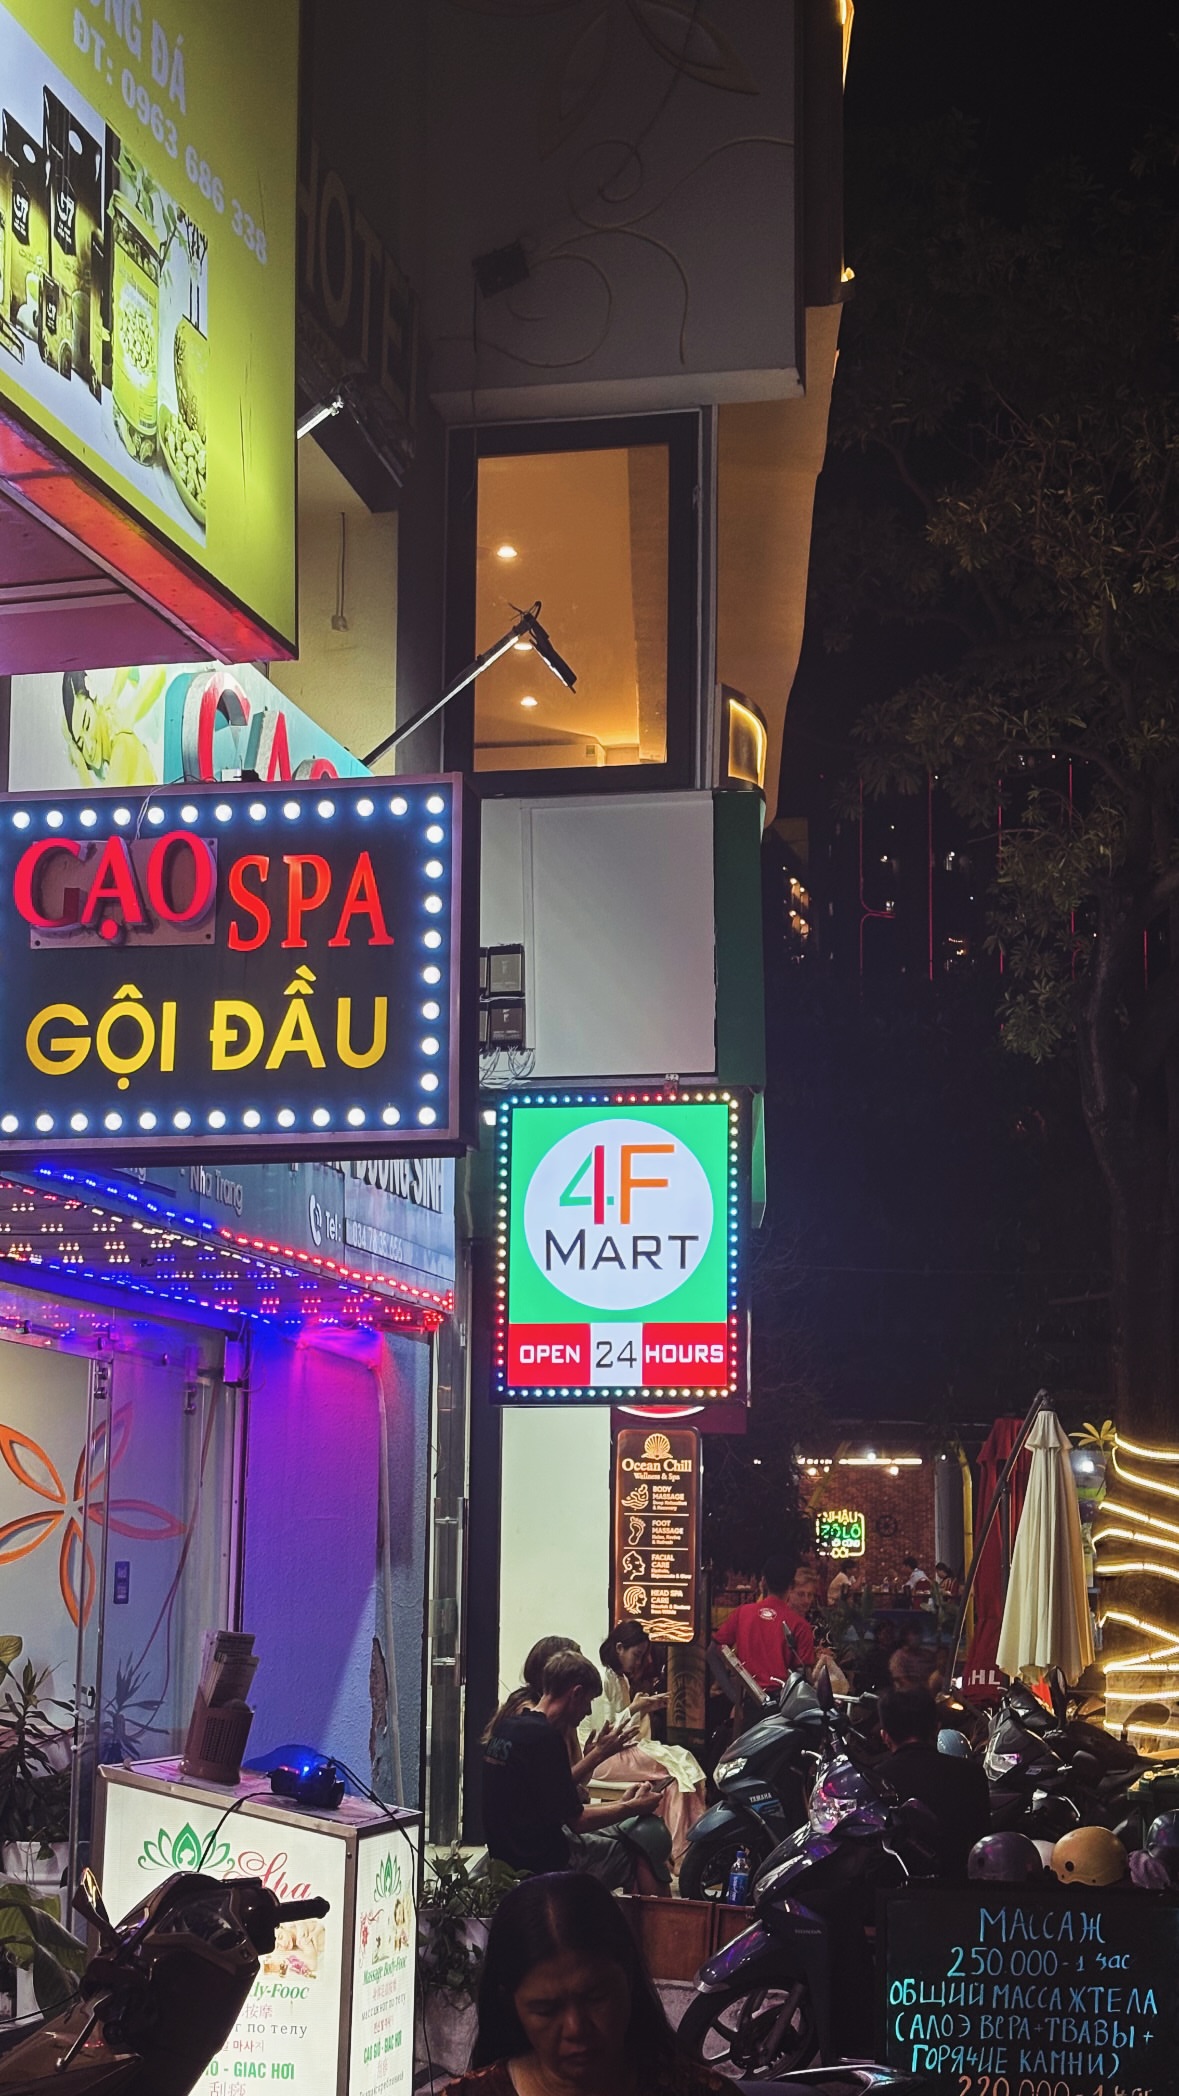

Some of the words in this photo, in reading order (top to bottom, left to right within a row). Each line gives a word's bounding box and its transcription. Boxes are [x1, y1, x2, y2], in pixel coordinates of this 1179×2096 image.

[121, 68, 178, 159] 0963
[185, 144, 225, 215] 686
[232, 199, 267, 265] 338
[13, 830, 216, 940] CẠO
[228, 851, 394, 952] SPA
[26, 984, 177, 1090] GỘI
[210, 965, 388, 1071] ĐẦU
[190, 1165, 213, 1198] Nha
[215, 1169, 243, 1216] Trang
[559, 1143, 675, 1225] 4F
[545, 1229, 699, 1271] MART
[519, 1344, 580, 1364] OPEN
[595, 1340, 637, 1368] 24
[645, 1344, 724, 1364] HOURS
[621, 1458, 661, 1472] Ocean
[663, 1459, 692, 1473] Chill
[652, 1485, 672, 1493] BODY
[652, 1493, 684, 1501] MASSAGE
[651, 1519, 671, 1527] FOOT
[651, 1527, 684, 1535] MASSAGE
[650, 1554, 675, 1562] FACIAL
[650, 1561, 670, 1569] CARE
[749, 1792, 772, 1803] YAMAHA
[979, 1906, 1106, 1944] МАССАЖ
[247, 2024, 265, 2034] по
[271, 2024, 307, 2039] телу
